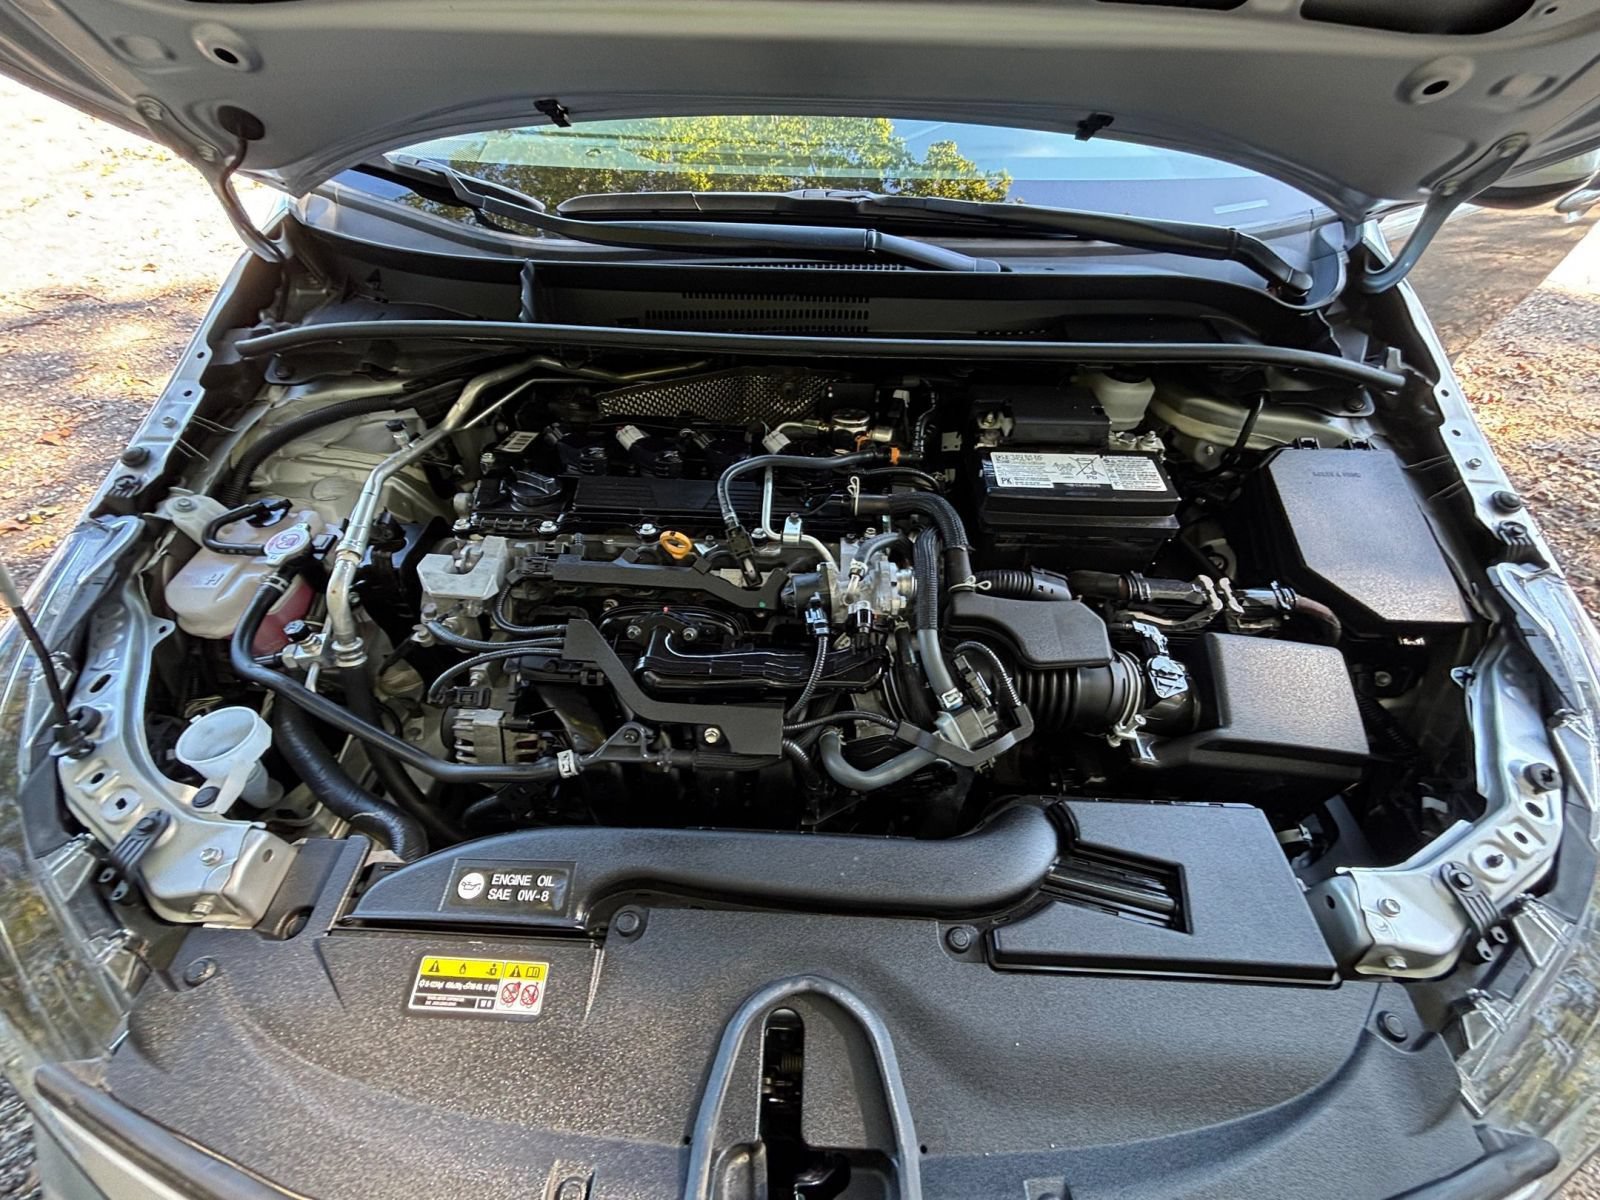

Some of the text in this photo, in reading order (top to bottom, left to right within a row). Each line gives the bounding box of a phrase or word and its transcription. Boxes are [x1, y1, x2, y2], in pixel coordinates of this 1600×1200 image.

[491, 874, 555, 887] ENGINE OIL
[487, 888, 550, 902] SAE 0W-8
